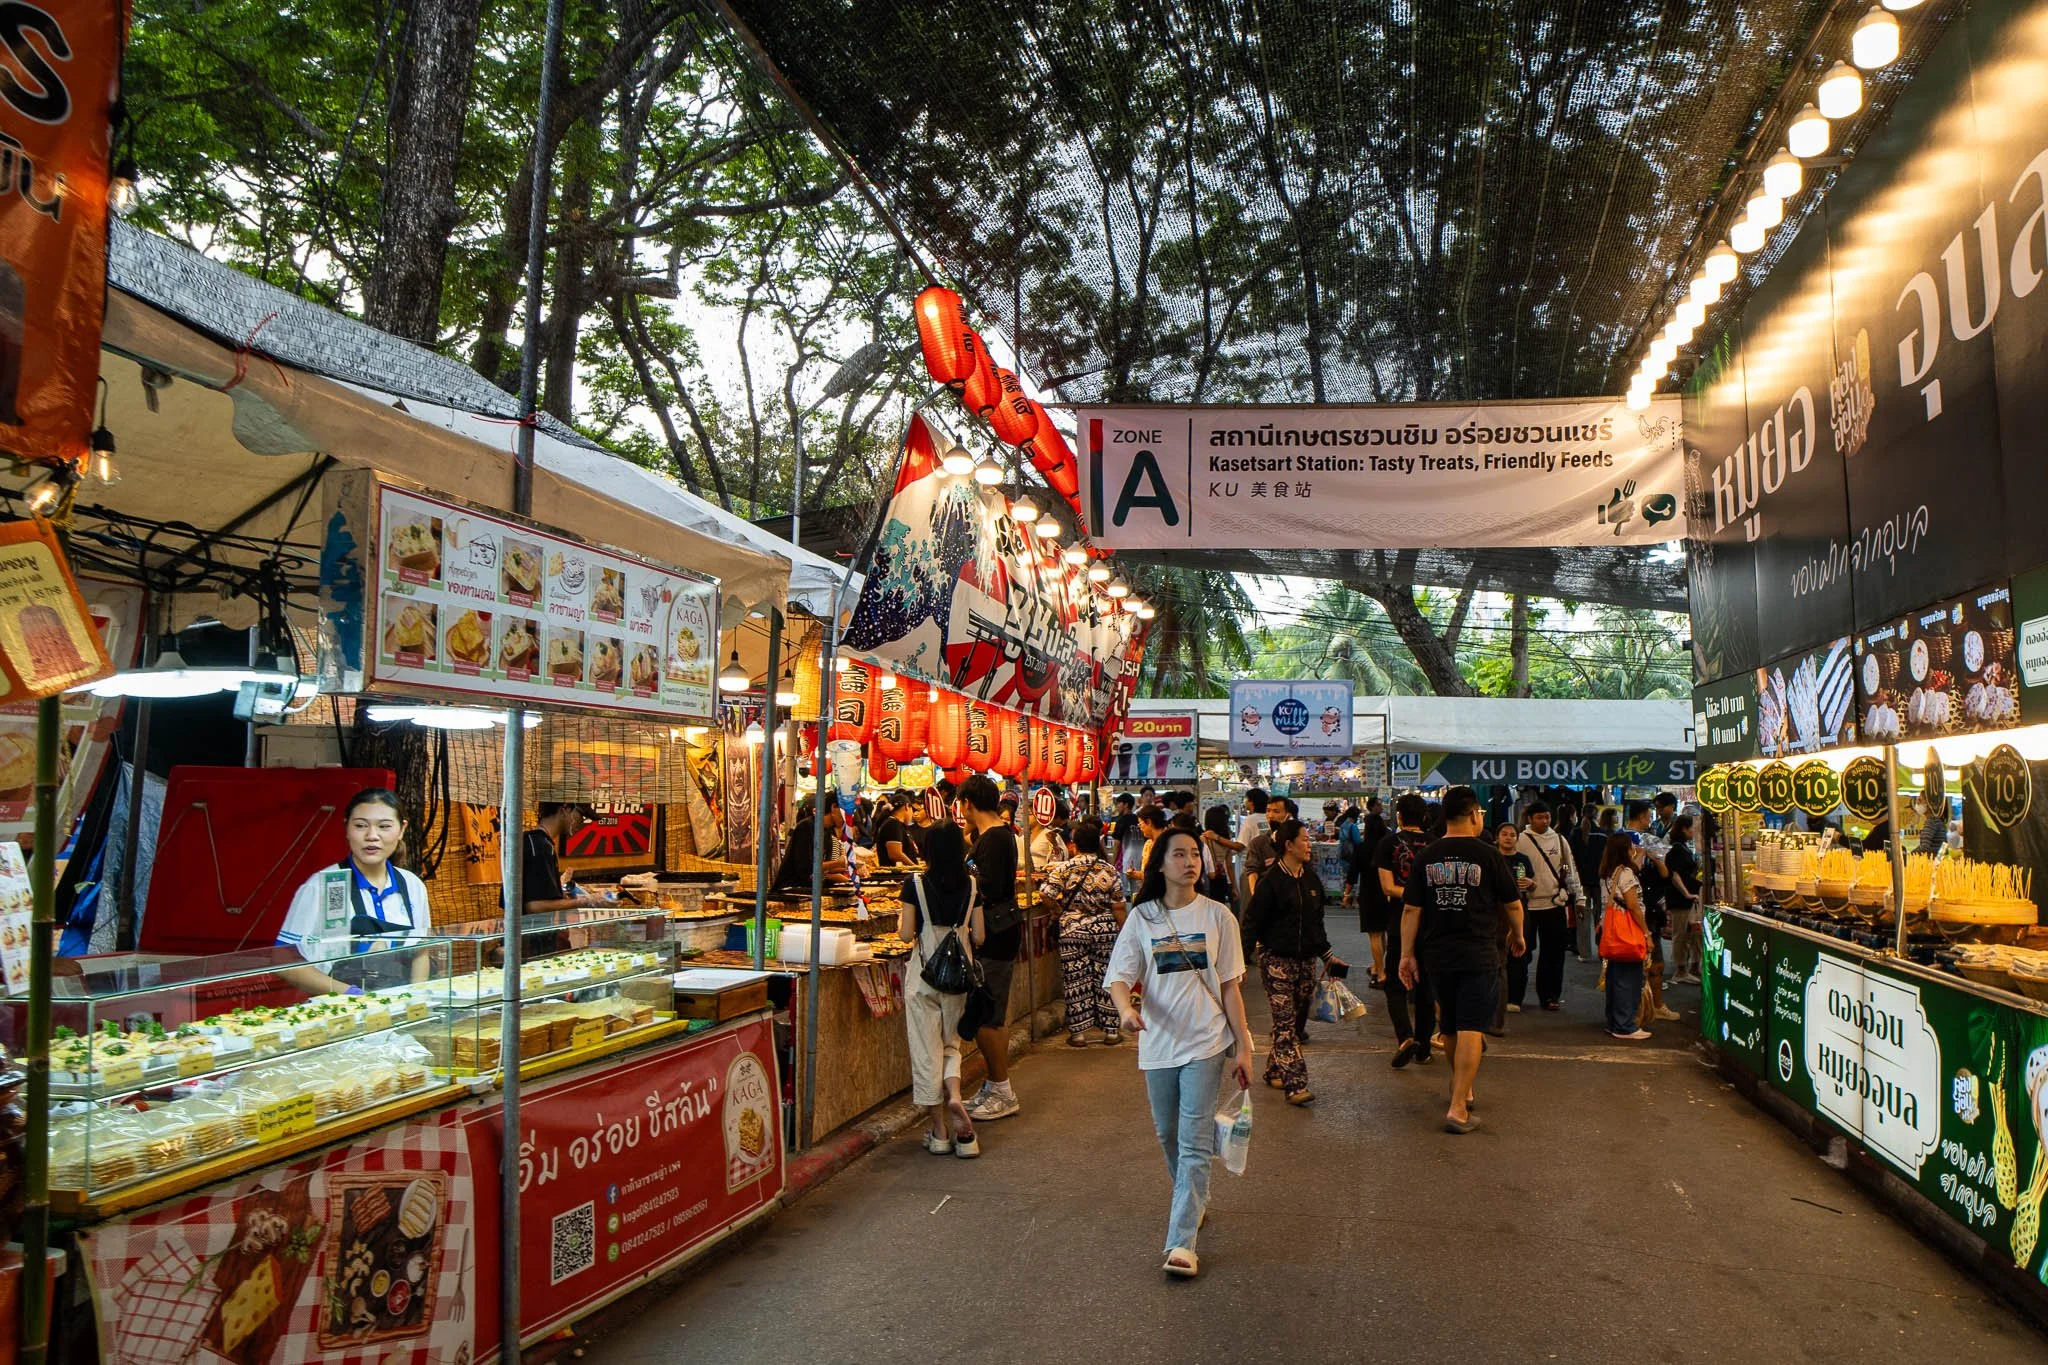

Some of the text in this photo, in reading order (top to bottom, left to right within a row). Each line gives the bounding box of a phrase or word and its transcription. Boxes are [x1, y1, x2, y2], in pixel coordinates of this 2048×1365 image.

[1112, 430, 1162, 444] ZONE
[1209, 417, 1613, 447] สถานีเกษตรชวนชิม อร่อยชวนแชร์
[1209, 450, 1614, 474] Kasetsart Station: Tasty Treats, Friendly Feeds
[1712, 385, 1816, 544] หมูยอ
[1112, 450, 1180, 527] A
[1209, 481, 1313, 498] KU 美食站
[446, 580, 497, 603] ของทานเล่น
[676, 607, 705, 626] KAGA
[1024, 654, 1036, 668] EST
[1278, 706, 1293, 715] KU
[1720, 695, 1729, 715] 10
[1730, 695, 1745, 713] บาท
[1132, 721, 1183, 733] 20บาท
[1275, 708, 1307, 727] milk
[1712, 726, 1721, 745] 10
[1394, 754, 1419, 770] KU
[1472, 760, 1506, 780] KU
[1517, 759, 1588, 780] BOOK
[1602, 755, 1656, 782] Life
[1735, 780, 1756, 798] 10
[1766, 779, 1788, 799] 10
[1802, 778, 1828, 800] 10
[1854, 778, 1879, 801] 10
[1995, 774, 2015, 803] 10
[928, 793, 942, 819] 10
[1037, 793, 1052, 815] 10
[1425, 862, 1482, 887] TOKYO
[1828, 987, 1905, 1049] ตองอ่อน
[732, 1079, 764, 1107] KAGA
[1818, 1043, 1919, 1130] หมูยออุบล
[568, 1112, 641, 1169] อร่อย
[1941, 1138, 1996, 1189] ของฝาก
[1940, 1173, 1998, 1228] จากอุบล
